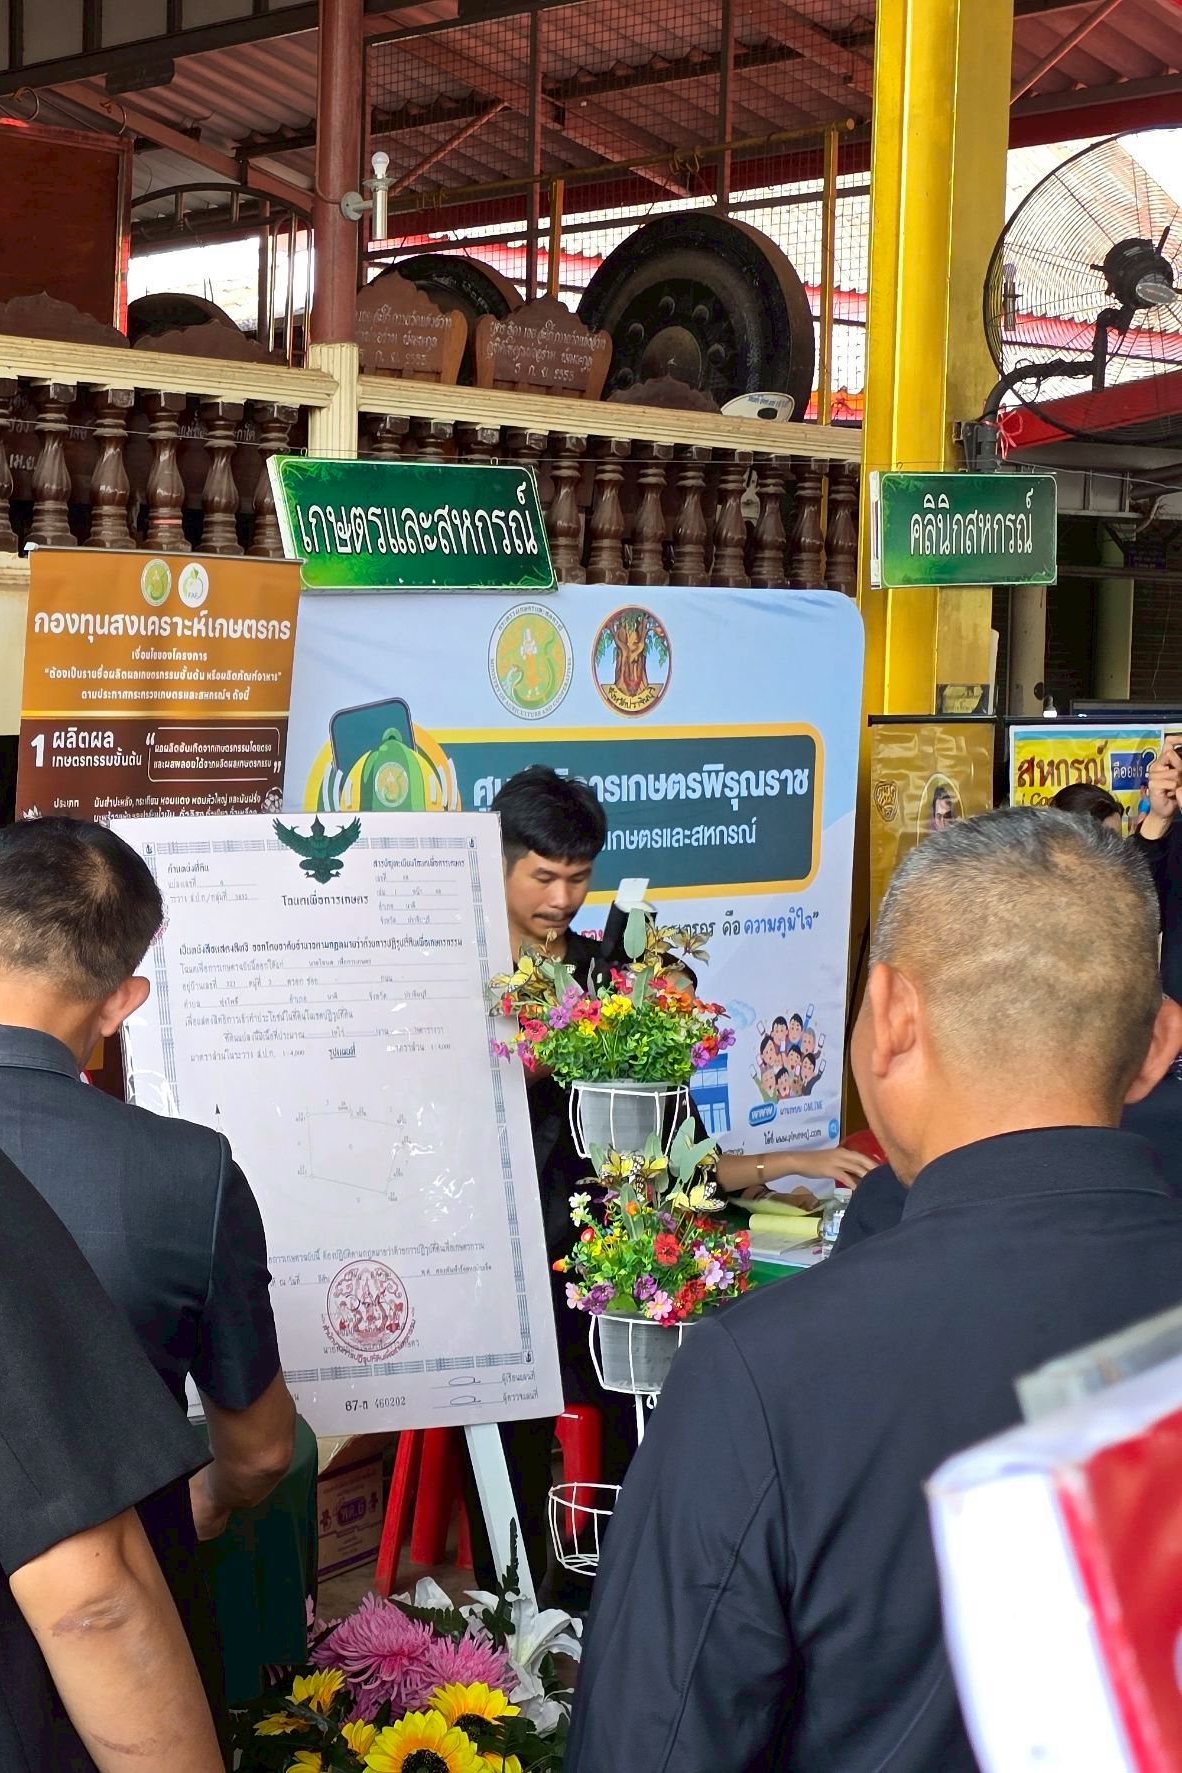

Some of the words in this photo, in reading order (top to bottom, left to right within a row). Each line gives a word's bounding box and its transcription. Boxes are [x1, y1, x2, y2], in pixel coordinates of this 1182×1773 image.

[296, 482, 538, 556] เกษตรและสหกรณ์
[910, 488, 1034, 555] คลินิกสหกรณ์
[33, 609, 291, 643] กองทุนสงเคราะห์เกษตรกร
[30, 733, 46, 768] 1
[52, 727, 114, 749] ผลิตผล
[52, 748, 142, 768] เกษตรกรรมขั้นต้น
[1017, 740, 1108, 787] สหกรณ์
[603, 817, 757, 851] เกษตรและสหกรณ์
[722, 910, 741, 936] คือ
